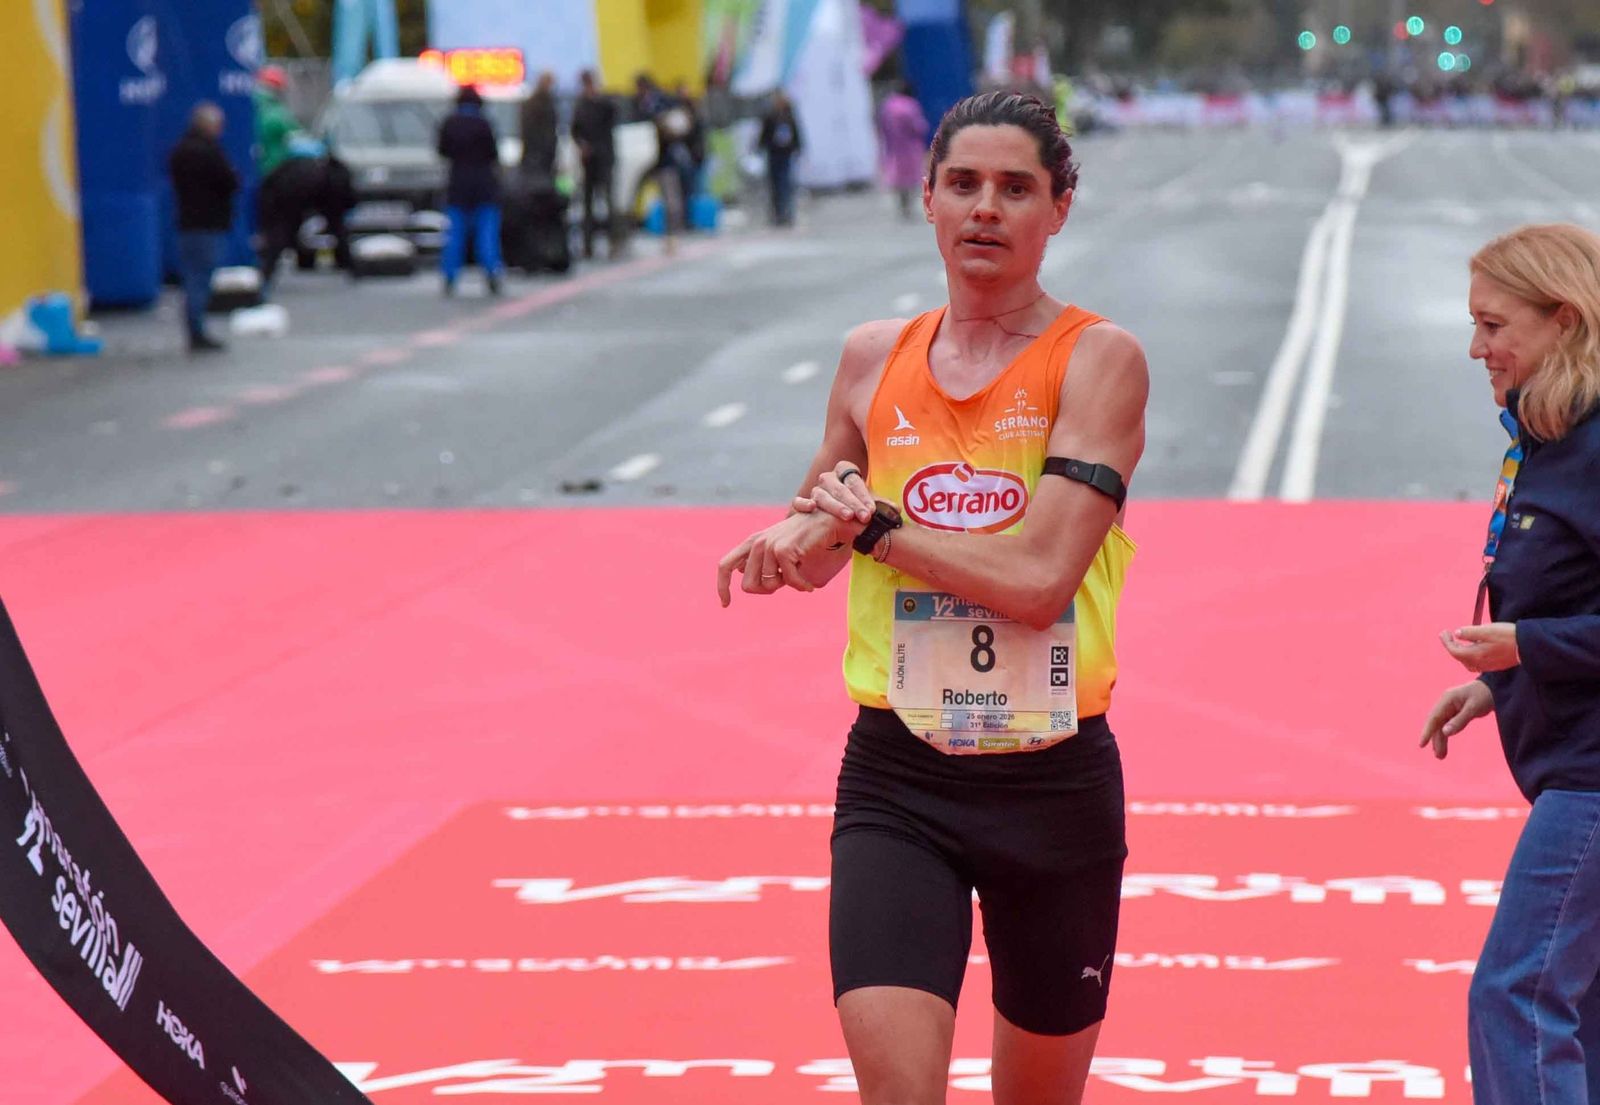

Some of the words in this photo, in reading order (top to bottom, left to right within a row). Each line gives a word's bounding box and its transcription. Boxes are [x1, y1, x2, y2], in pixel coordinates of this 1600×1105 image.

[994, 415, 1049, 433] SERRANO
[886, 434, 920, 447] rasán
[912, 481, 1020, 515] Serrano
[970, 625, 996, 673] 8
[942, 688, 1008, 706] Roberto
[966, 712, 976, 720] 25
[982, 720, 1009, 729] Edición
[948, 738, 976, 748] HOKA
[983, 739, 1016, 750] Sprinter
[155, 1000, 206, 1070] HOKA
